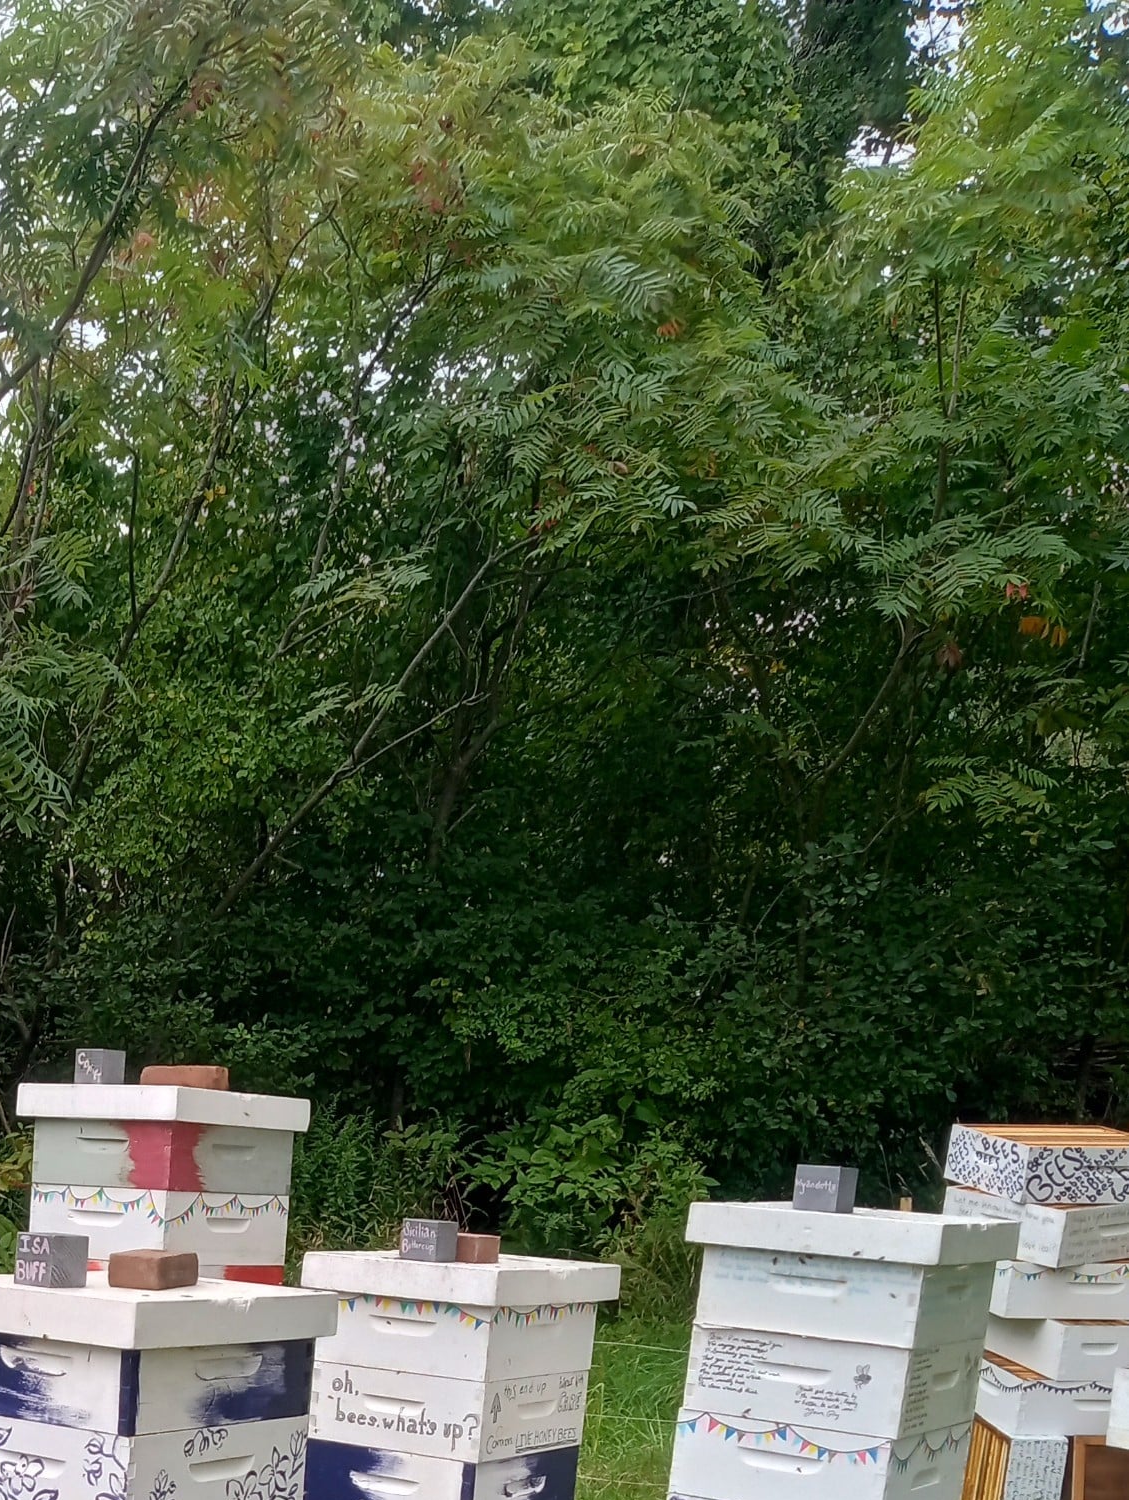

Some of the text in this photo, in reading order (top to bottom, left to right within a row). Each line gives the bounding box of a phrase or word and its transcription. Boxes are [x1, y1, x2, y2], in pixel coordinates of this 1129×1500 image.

[981, 1137, 1020, 1164] BEES
[1025, 1146, 1084, 1203] BEES
[403, 1221, 436, 1239] Sicilian
[19, 1236, 51, 1255] ISA
[16, 1260, 48, 1283] BUFF
